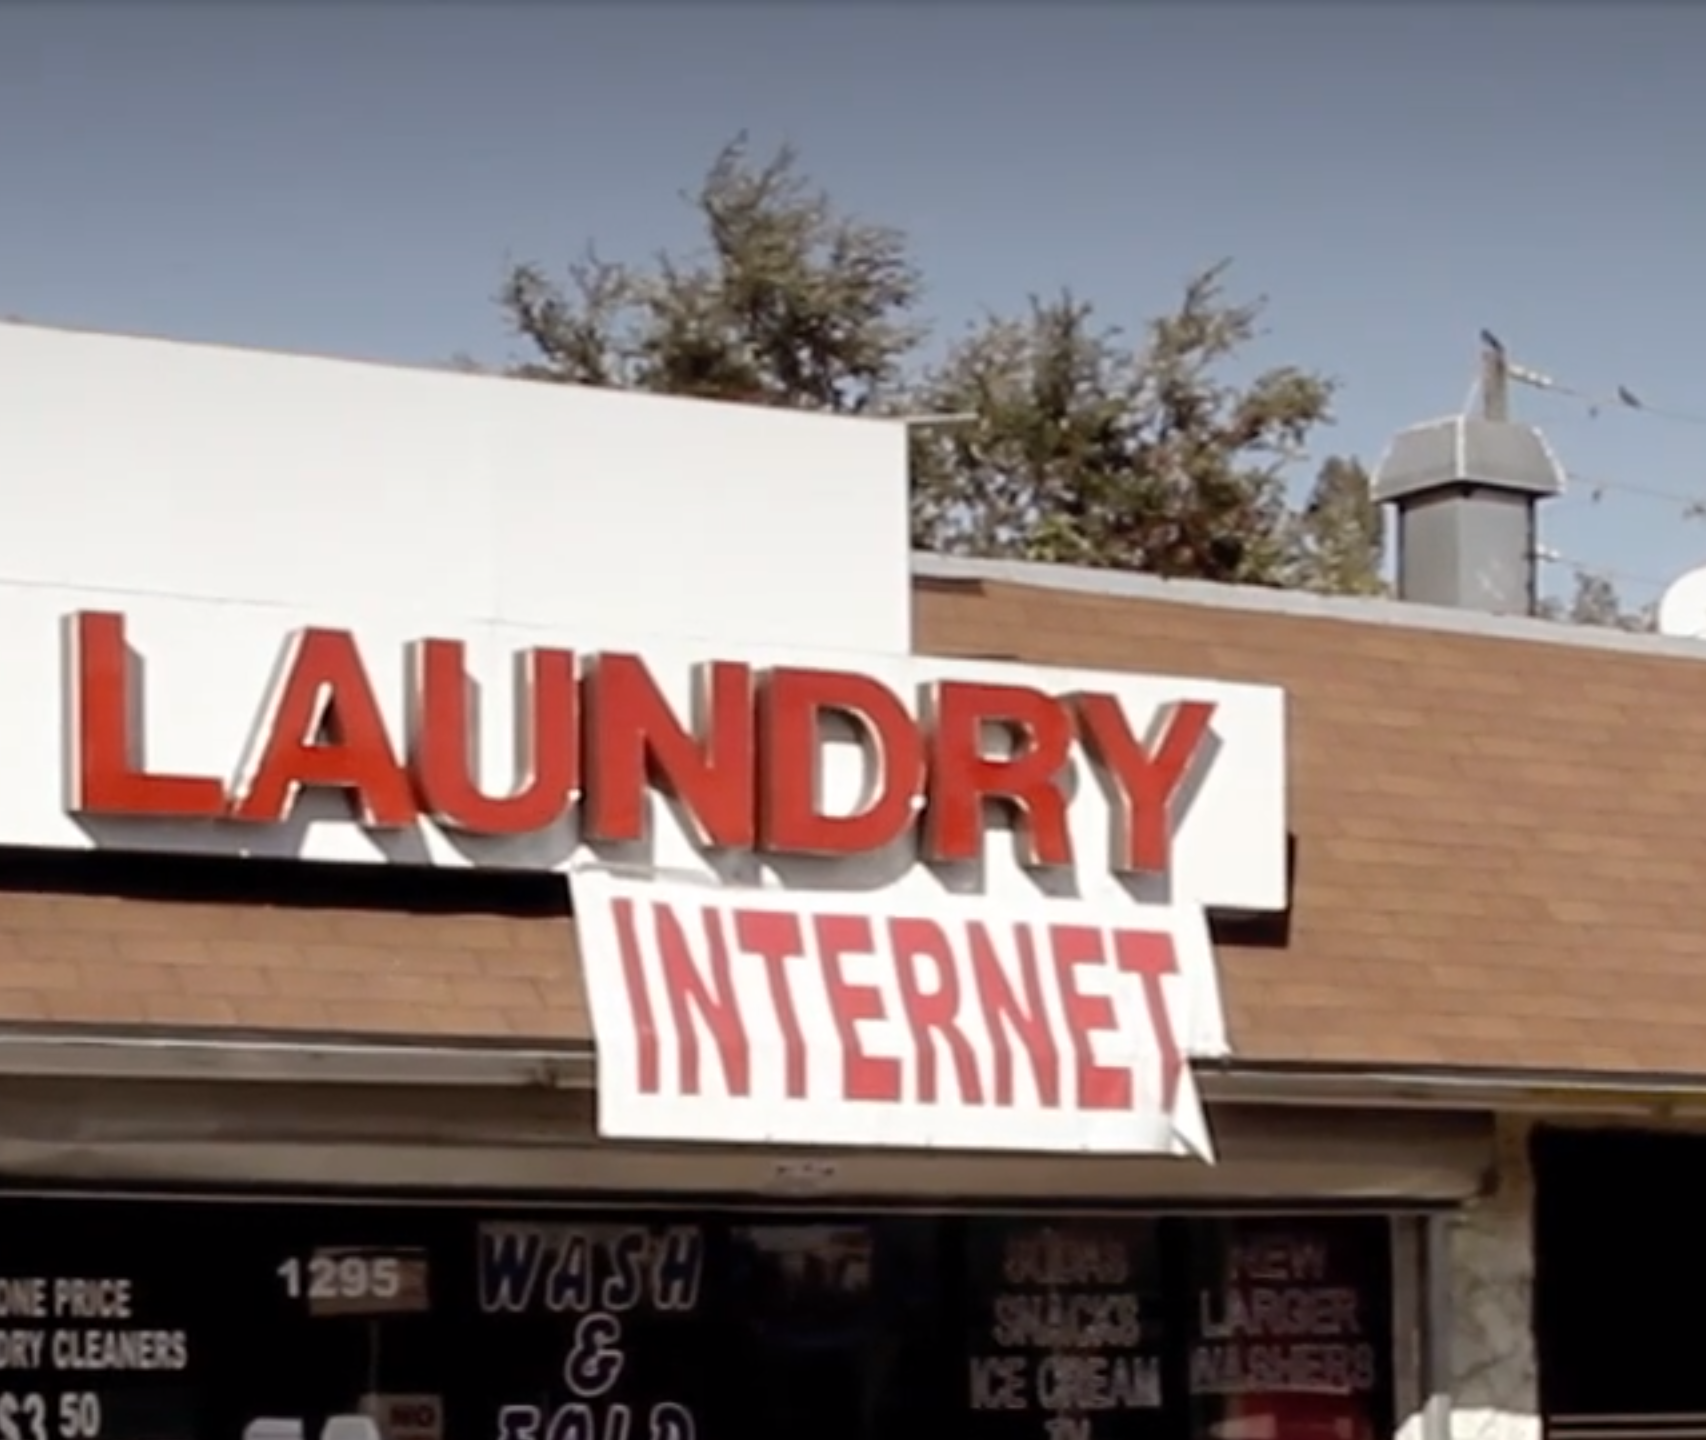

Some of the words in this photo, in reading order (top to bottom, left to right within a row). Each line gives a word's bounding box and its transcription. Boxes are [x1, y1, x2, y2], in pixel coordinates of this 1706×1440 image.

[67, 611, 1217, 872] LAUNDRY
[612, 898, 1184, 1109] INTERNET
[276, 1257, 399, 1298] 1295
[478, 1225, 701, 1311] WASH
[54, 1278, 132, 1317] PRICE
[994, 1295, 1140, 1348] SNACKS
[1201, 1288, 1362, 1338] LARGER
[52, 1329, 188, 1369] CLEANERS
[565, 1312, 624, 1397] &
[1190, 1343, 1374, 1392] WASHERS
[970, 1356, 1027, 1409] ICE
[1037, 1356, 1162, 1409] CREAM
